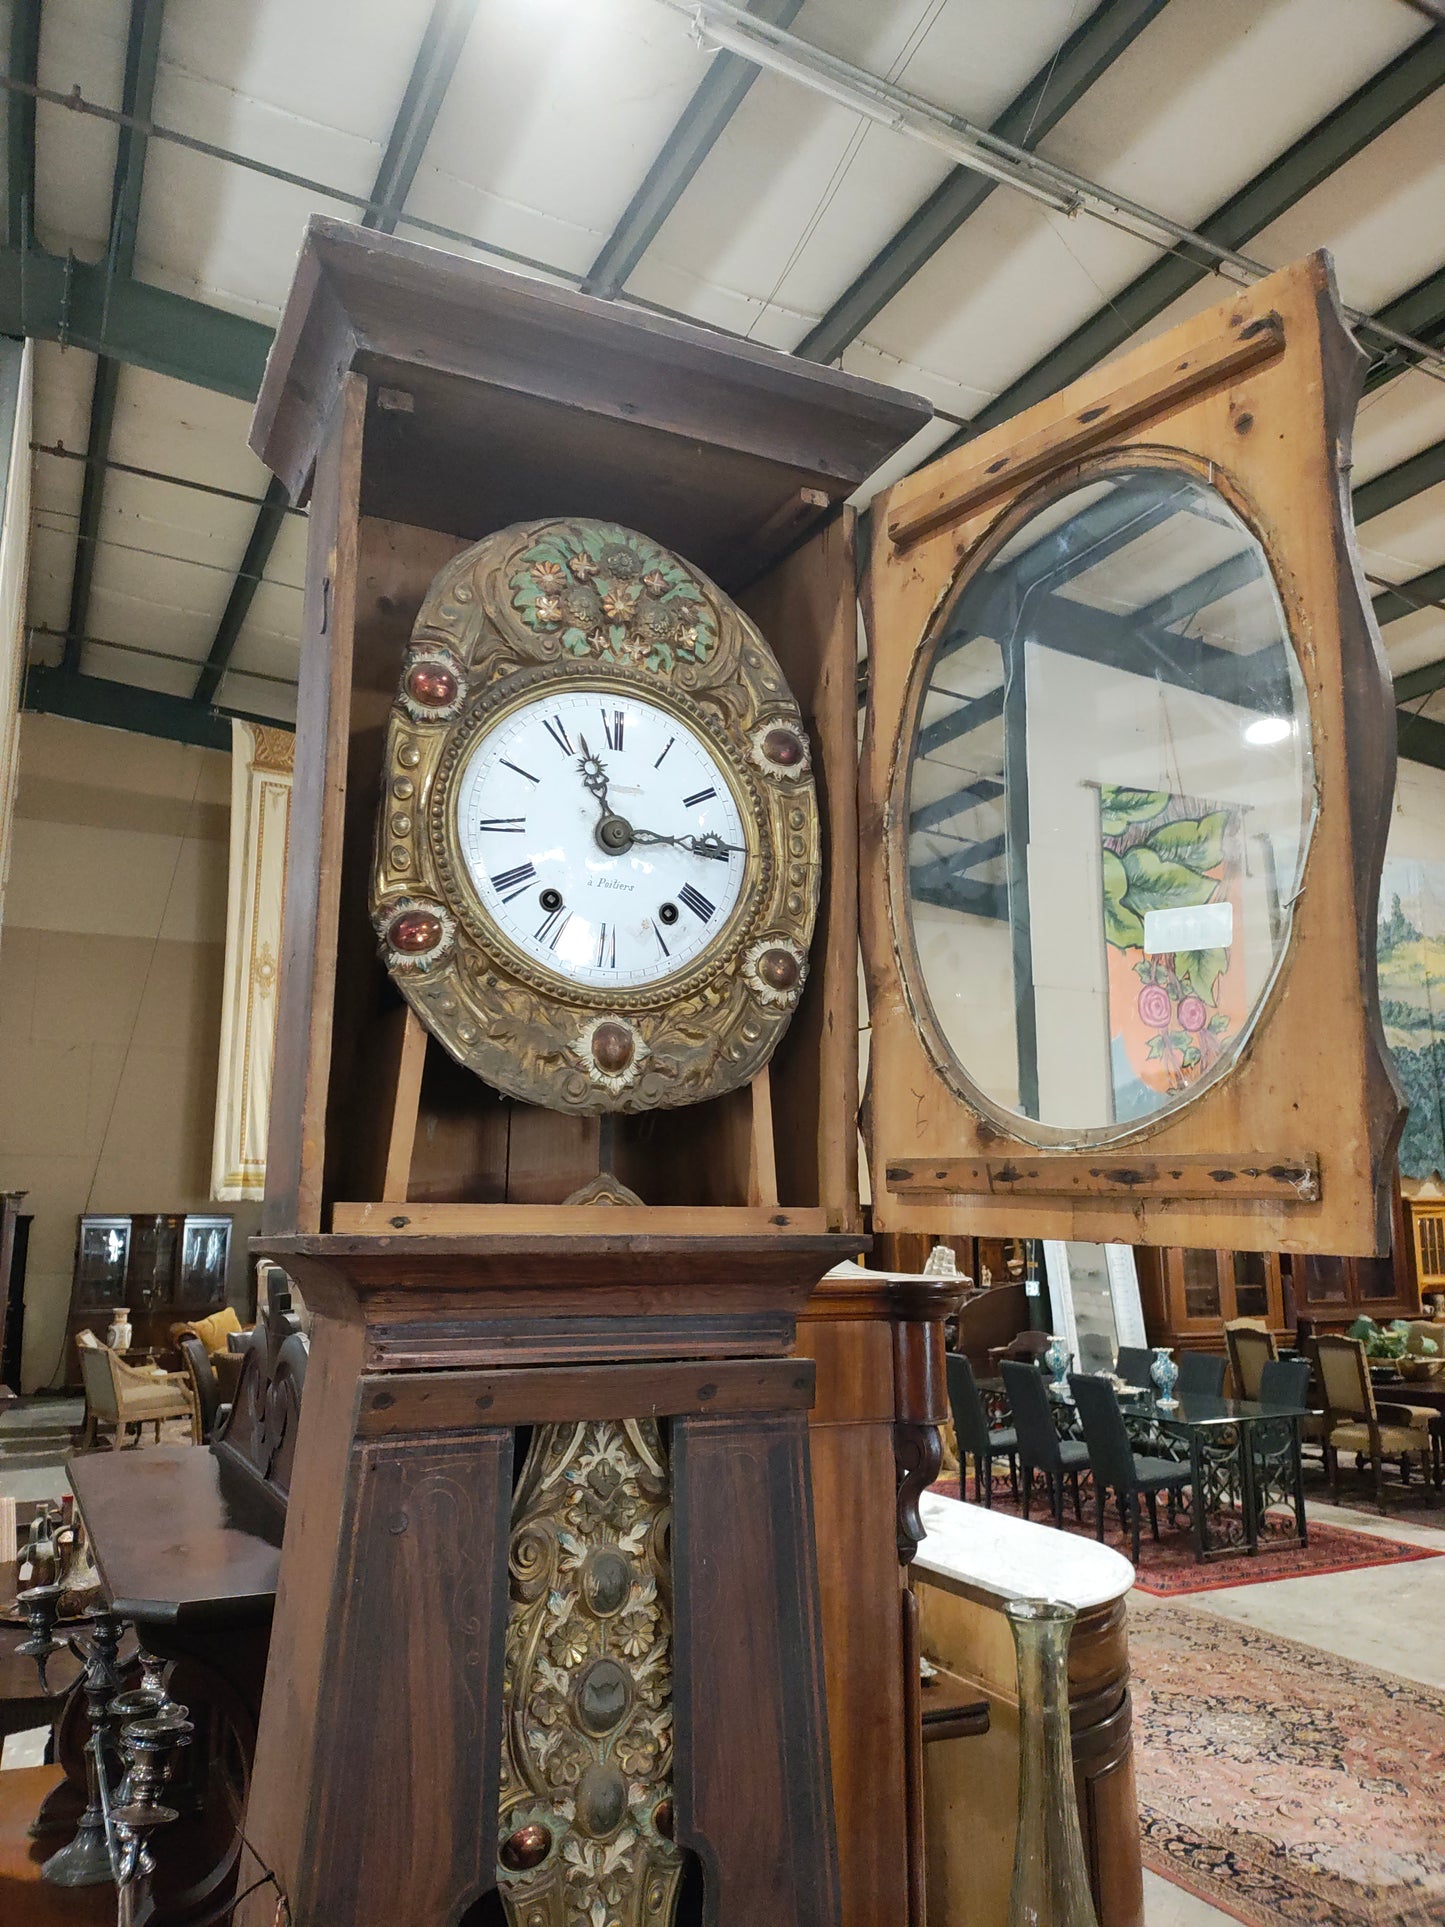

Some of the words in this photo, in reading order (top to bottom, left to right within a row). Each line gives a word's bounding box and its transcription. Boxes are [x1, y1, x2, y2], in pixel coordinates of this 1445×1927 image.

[541, 713, 576, 760] XI
[600, 708, 627, 752] XII
[681, 786, 718, 808] II
[490, 862, 541, 904] VIII
[676, 882, 716, 925] IIII
